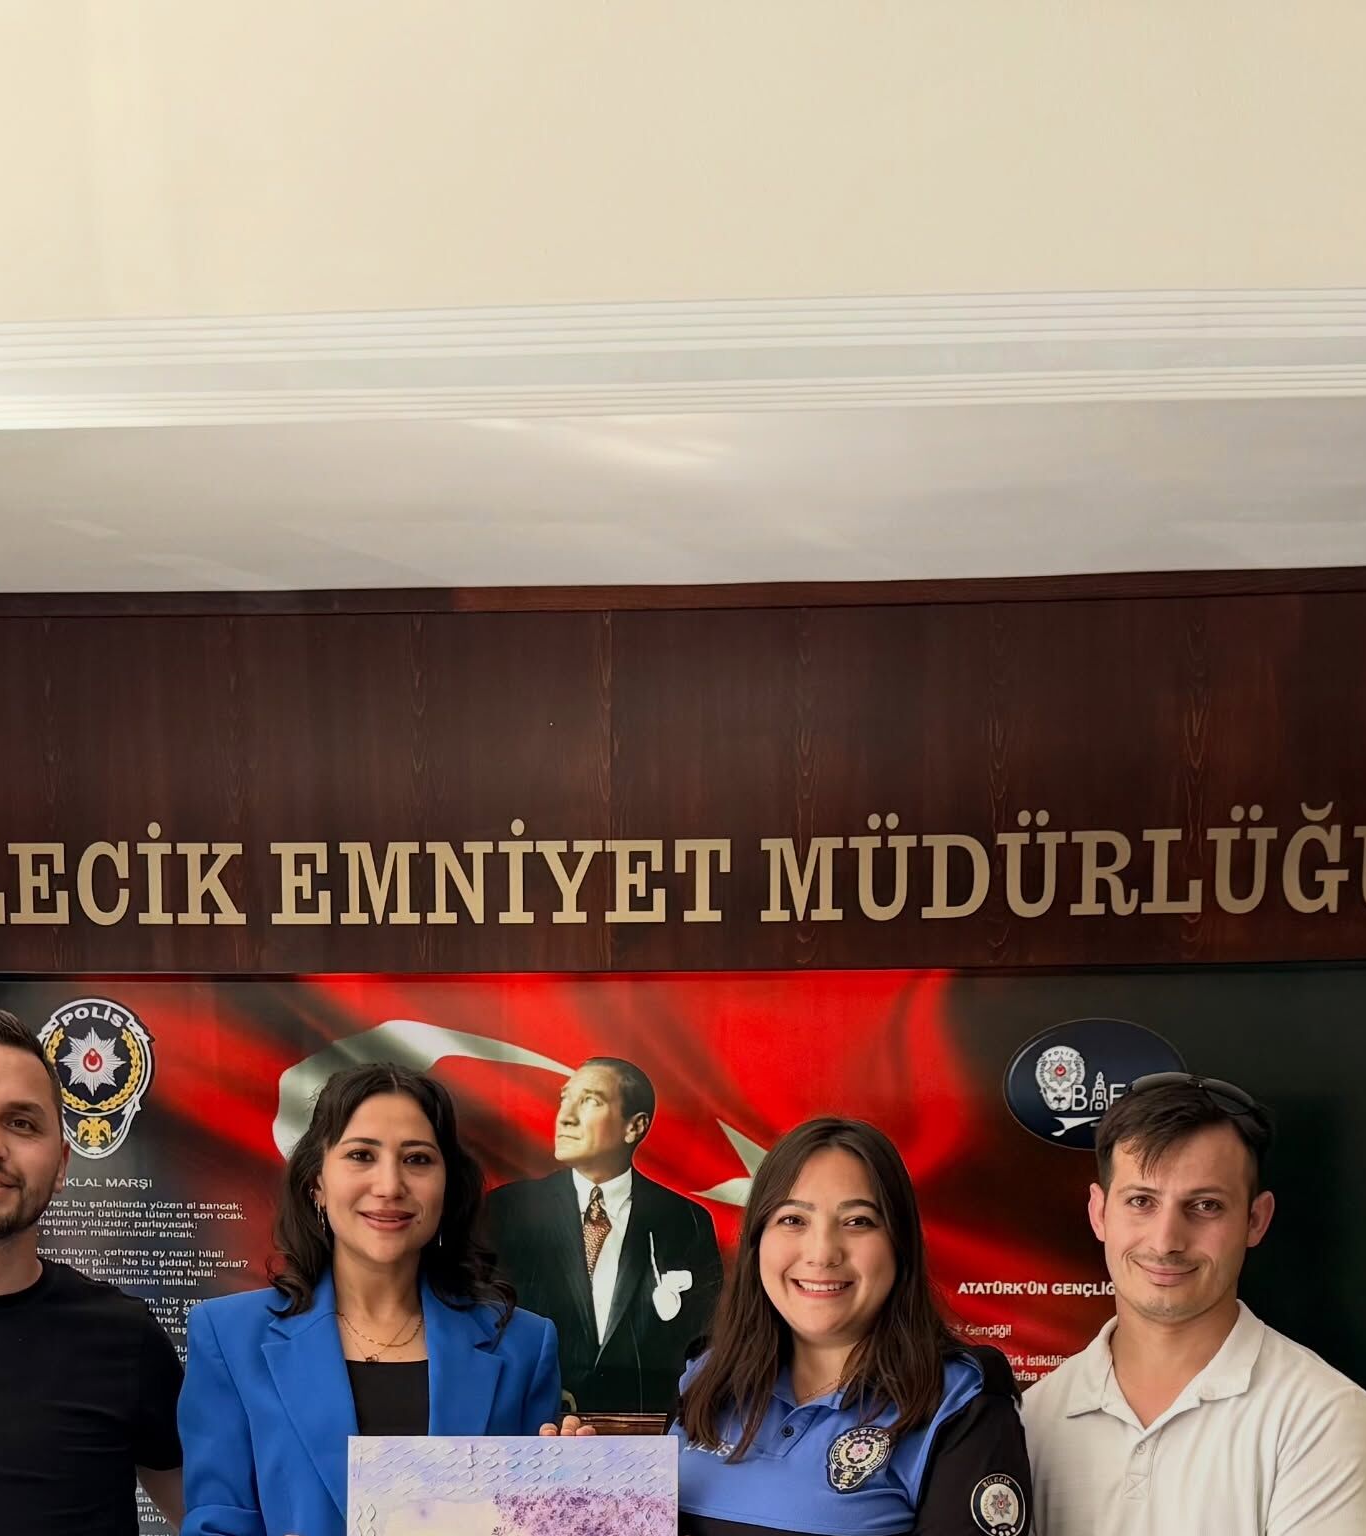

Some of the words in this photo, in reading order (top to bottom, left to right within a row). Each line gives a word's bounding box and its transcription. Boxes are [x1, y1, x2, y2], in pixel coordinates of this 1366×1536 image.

[271, 818, 732, 926] EMNİYET
[61, 1006, 124, 1028] POLİS
[106, 1178, 153, 1190] MARŞI
[72, 1200, 86, 1208] bu
[89, 1200, 147, 1209] şafaklarda
[150, 1201, 183, 1210] yüzen
[187, 1202, 196, 1210] al
[200, 1203, 243, 1211] sancak;
[98, 1210, 142, 1218] üstünde
[145, 1211, 173, 1219] tüten
[217, 1212, 247, 1220] ocak.
[81, 1219, 131, 1229] yıldızıdır,
[134, 1221, 198, 1230] parlayacak;
[53, 1229, 87, 1237] benim
[159, 1230, 196, 1239] ancak.
[61, 1247, 101, 1257] olayım,
[152, 1250, 166, 1258] ey
[75, 1257, 90, 1265] bir
[142, 1258, 156, 1266] bu
[198, 1259, 213, 1268] bu
[92, 1267, 150, 1276] kanlarımız
[153, 1269, 184, 1277] sonra
[1051, 1281, 1116, 1297] GENÇLİĞ
